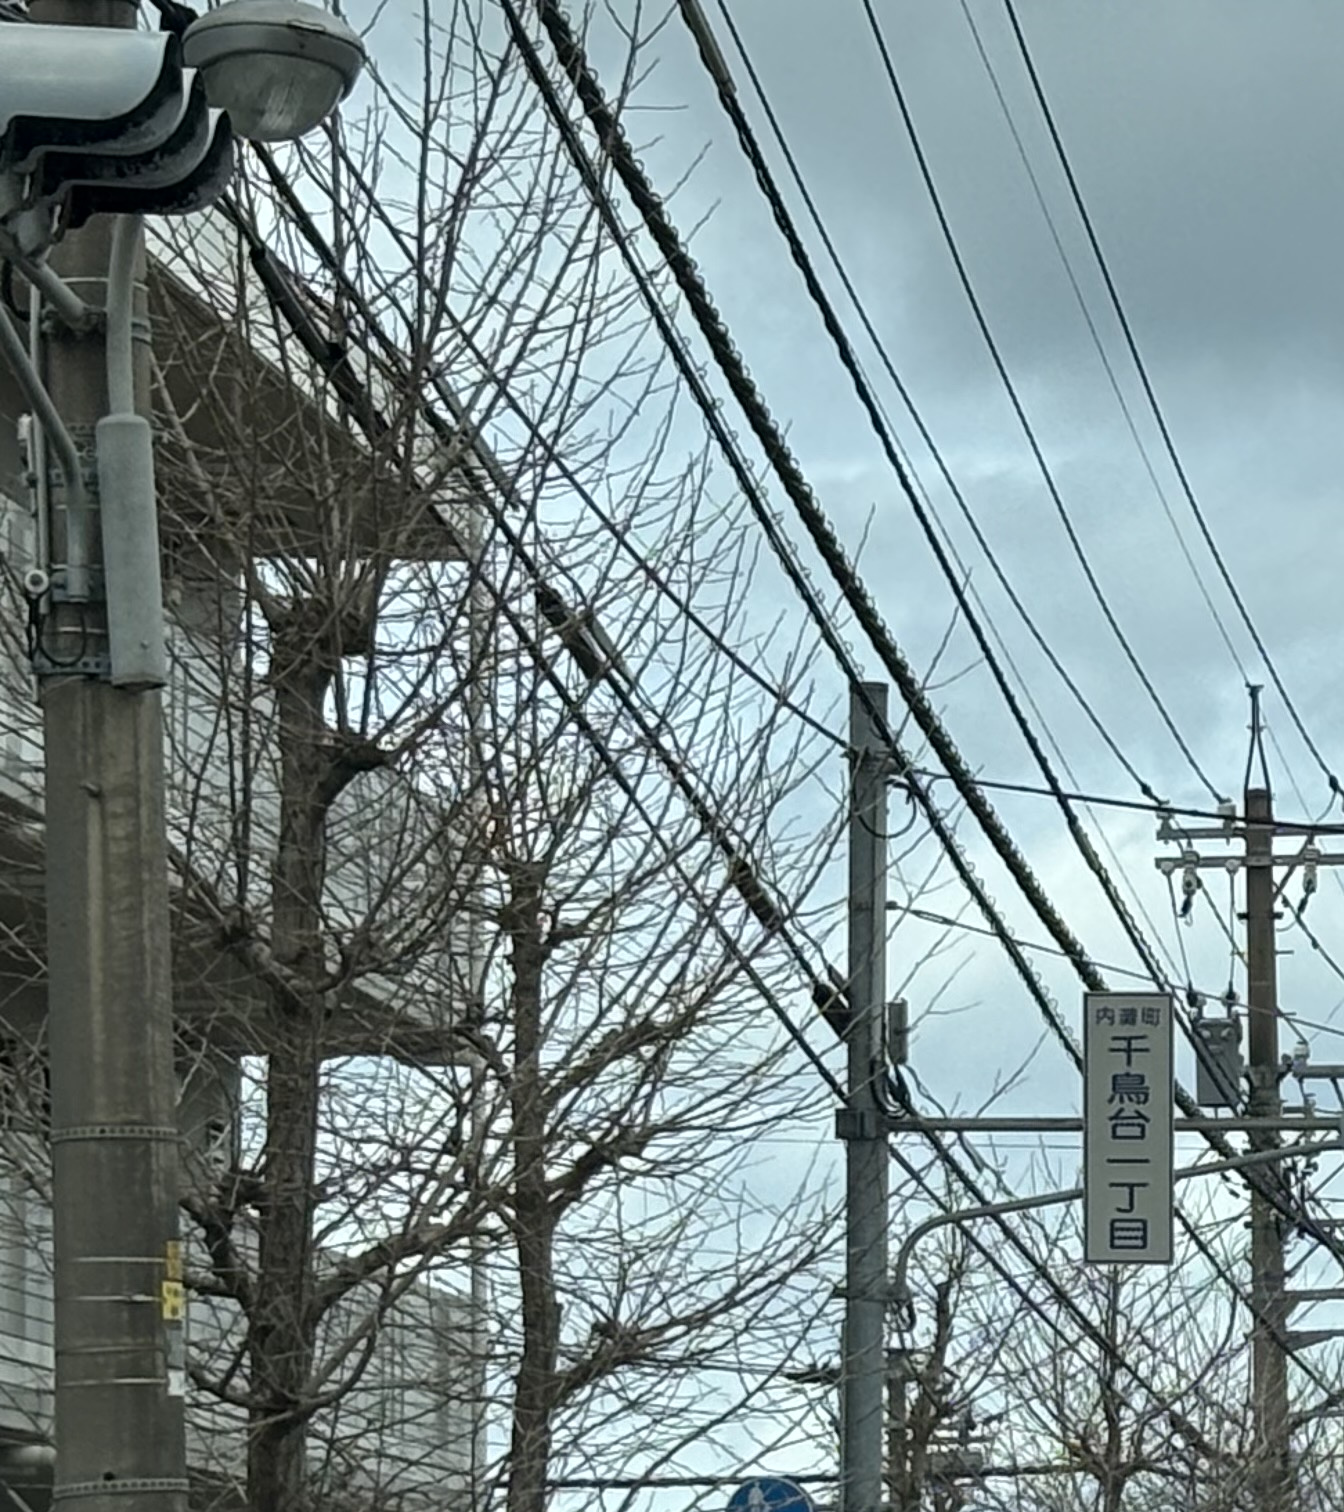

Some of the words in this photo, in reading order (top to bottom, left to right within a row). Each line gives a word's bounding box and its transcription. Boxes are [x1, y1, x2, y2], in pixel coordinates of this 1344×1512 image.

[1106, 1034, 1151, 1250] 千鳥台一丁目
